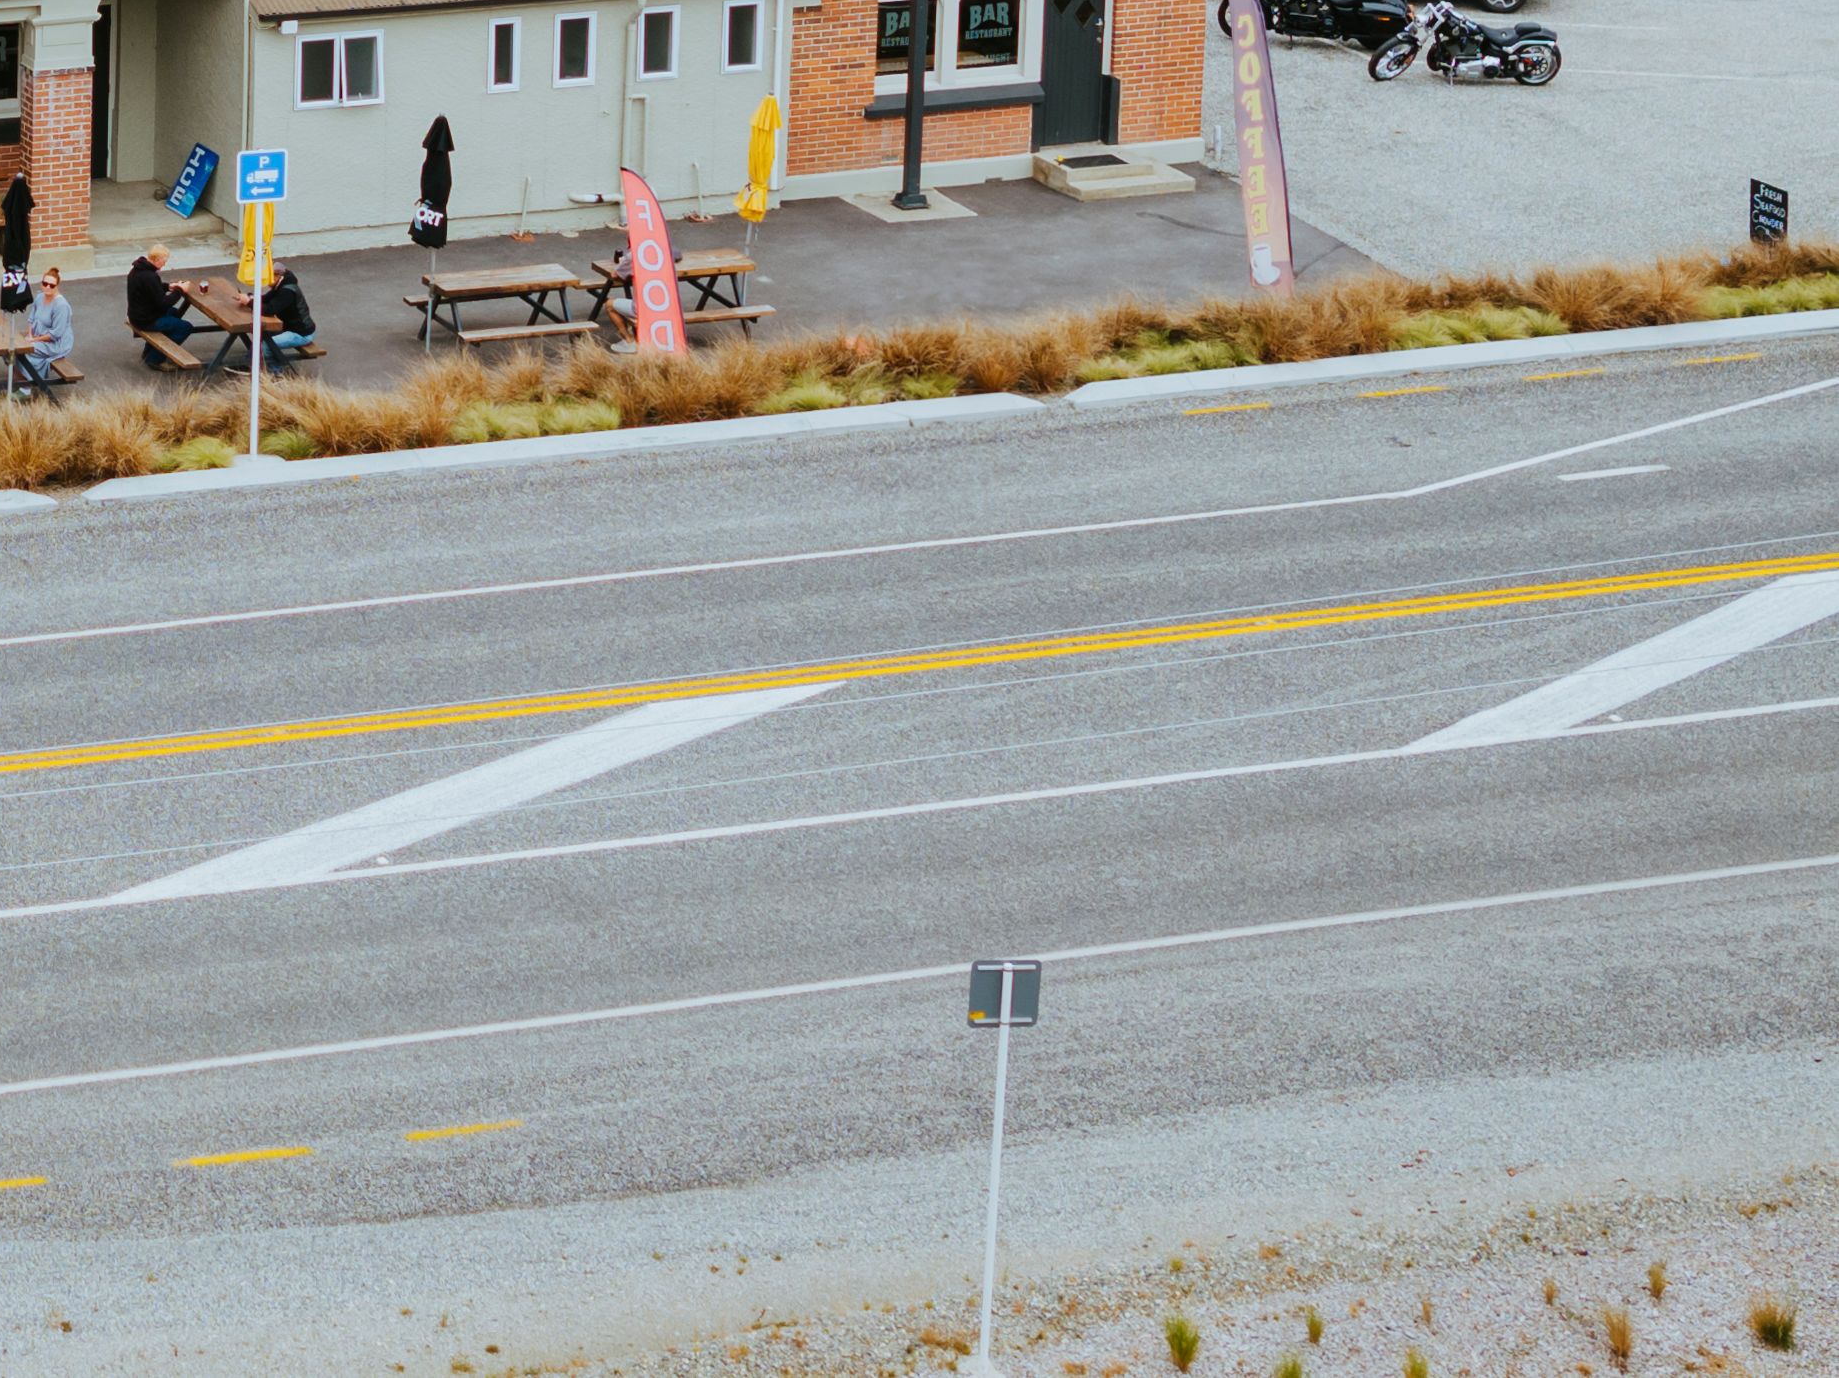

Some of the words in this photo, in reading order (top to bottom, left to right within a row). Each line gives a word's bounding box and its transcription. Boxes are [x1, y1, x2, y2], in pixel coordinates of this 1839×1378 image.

[885, 11, 911, 37] BA
[969, 1, 1009, 30] BAR
[965, 27, 1012, 40] RESTAURANT
[259, 155, 270, 169] P
[169, 146, 205, 206] ICE
[416, 206, 444, 227] ORT
